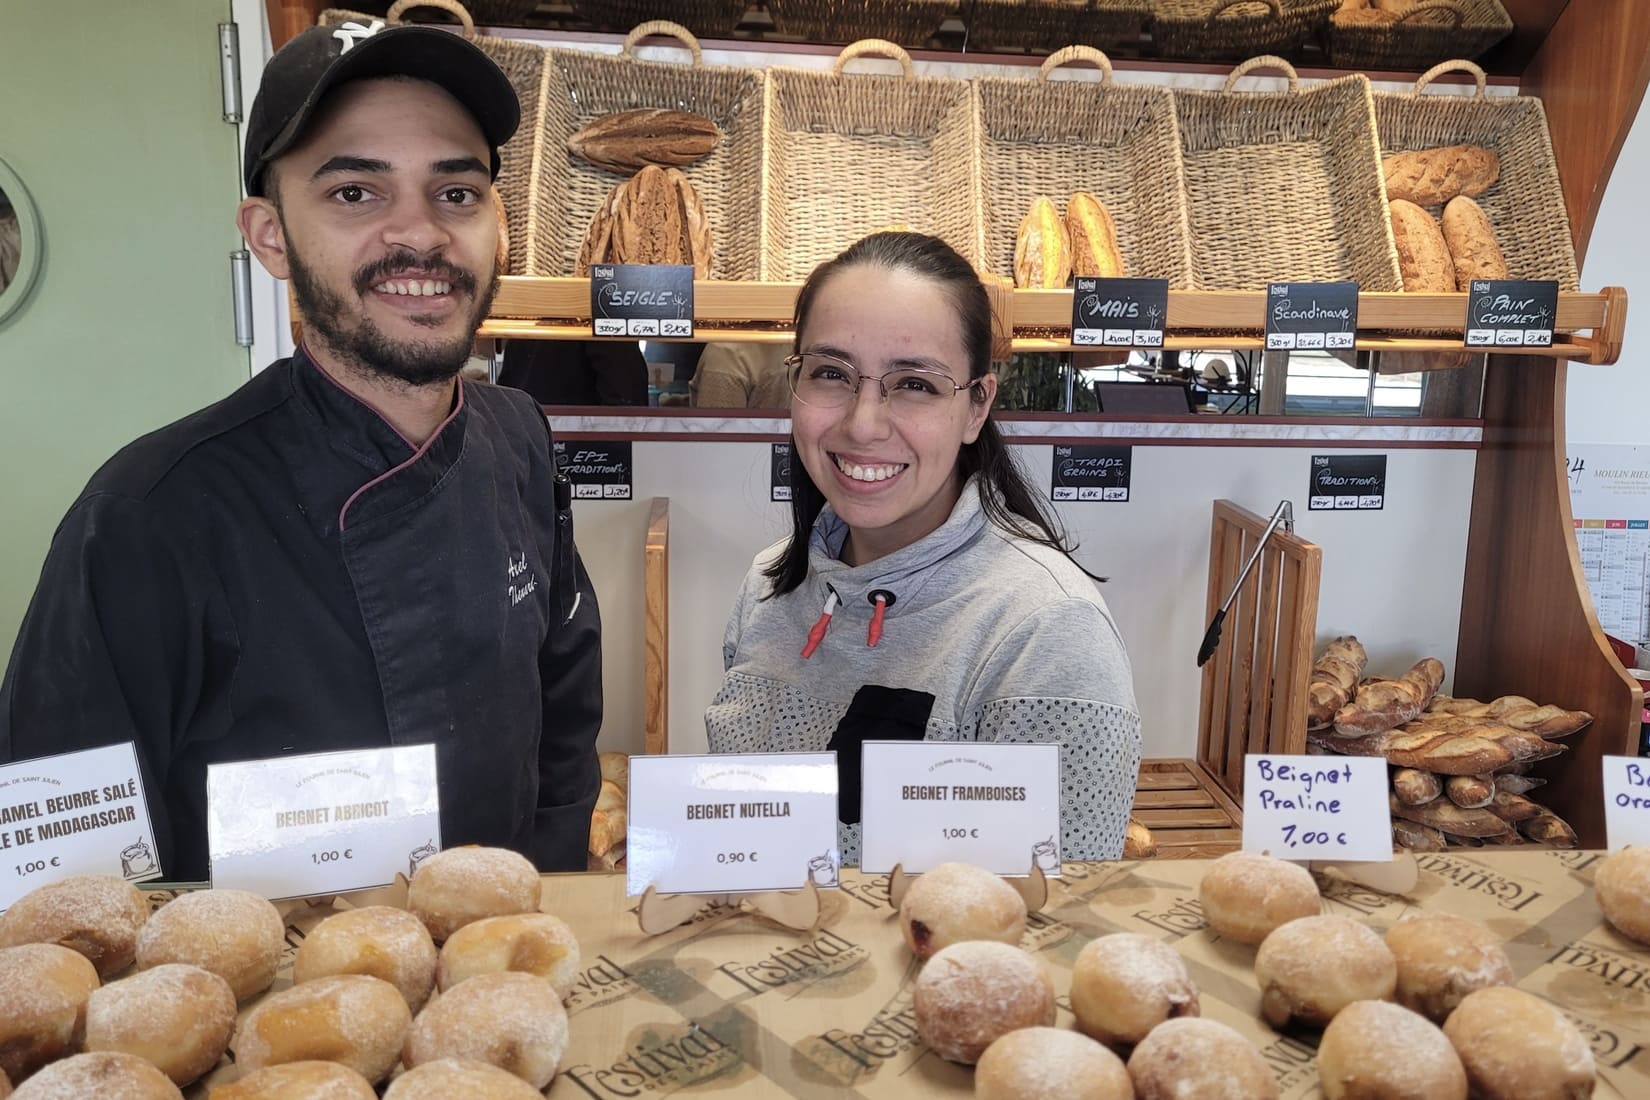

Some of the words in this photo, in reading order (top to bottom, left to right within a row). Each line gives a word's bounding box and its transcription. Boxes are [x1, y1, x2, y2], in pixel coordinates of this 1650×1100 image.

[609, 291, 673, 306] SEIGLE
[1490, 294, 1535, 311] PAIN
[1275, 299, 1351, 321] Scandinave
[1480, 312, 1541, 324] COMPLET
[573, 450, 608, 462] EPI
[1075, 458, 1123, 468] TRADI
[560, 463, 622, 475] TRADITION
[1063, 467, 1107, 477] GRAINS
[1319, 476, 1376, 486] TRADITION
[1258, 760, 1352, 793] Beignet
[46, 789, 100, 814] BEURRE
[102, 778, 138, 802] SALÉ
[902, 785, 948, 801] BEIGNET
[952, 786, 1026, 801] FRAMBOISES
[1259, 790, 1341, 813] Praline
[275, 807, 331, 829] BEIGNET
[334, 800, 389, 822] ABRICOT
[687, 803, 735, 820] BEIGNET
[739, 801, 790, 818] NUTELLA
[15, 828, 35, 846] DE
[37, 805, 136, 841] MADAGASCAR
[942, 828, 967, 840] 1,00
[970, 828, 979, 839] €
[311, 850, 340, 865] 1,00
[343, 848, 353, 860] €
[716, 852, 745, 865] 0,90
[749, 851, 758, 863] €
[15, 860, 46, 877] 1,00
[50, 856, 61, 868] €
[713, 928, 861, 996] Festival
[559, 1021, 732, 1100] Festival
